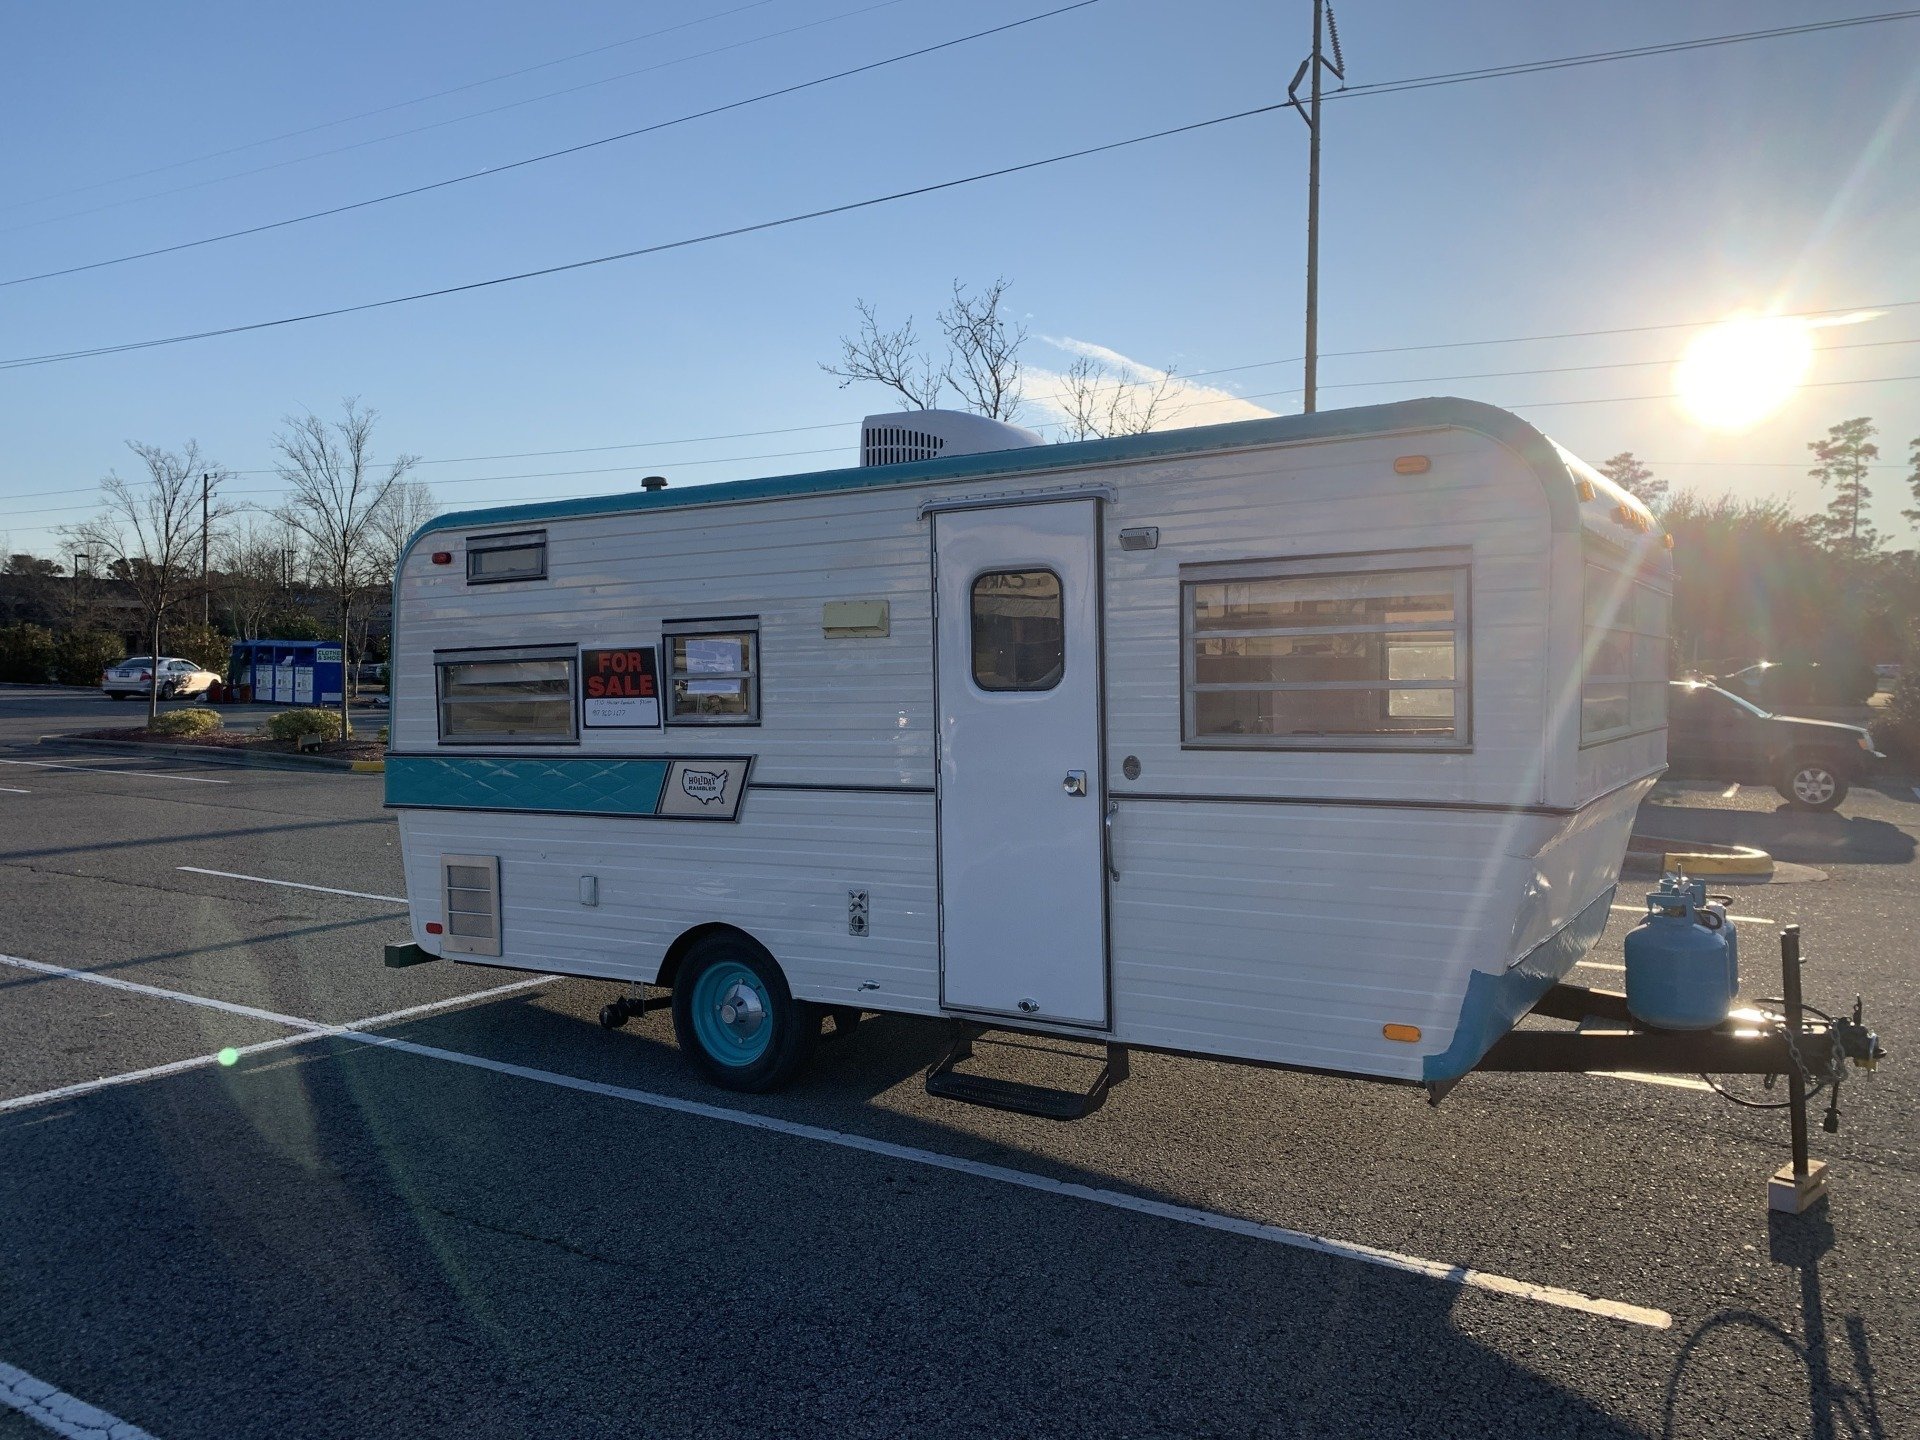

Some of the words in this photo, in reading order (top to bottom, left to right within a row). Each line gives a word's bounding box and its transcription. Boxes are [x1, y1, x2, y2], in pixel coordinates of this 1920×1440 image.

[598, 651, 643, 673] FOR
[588, 674, 654, 697] SALE
[688, 776, 716, 786] HOLIDAY
